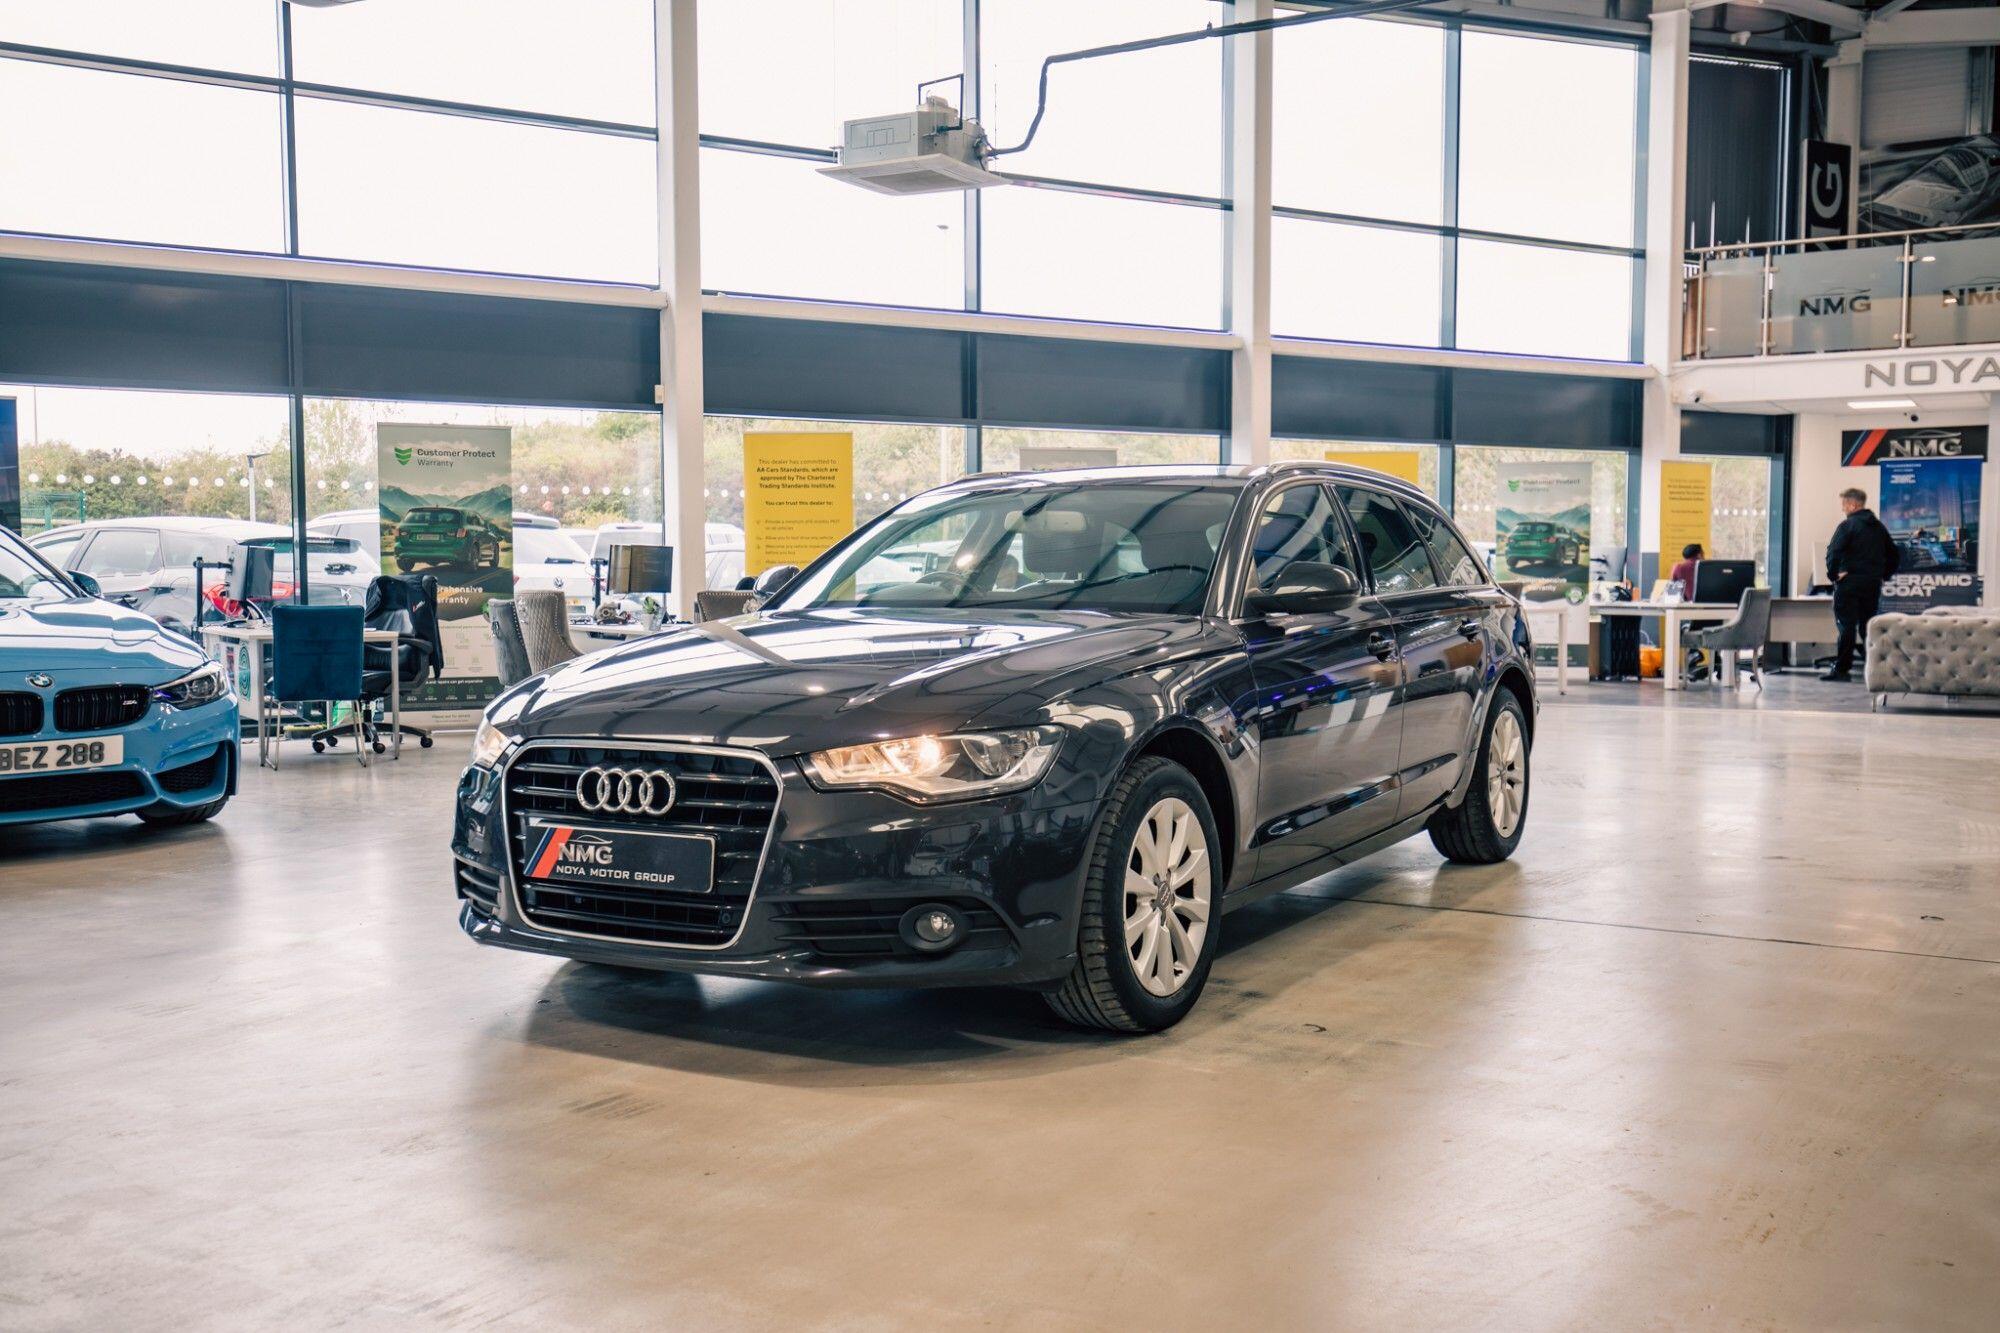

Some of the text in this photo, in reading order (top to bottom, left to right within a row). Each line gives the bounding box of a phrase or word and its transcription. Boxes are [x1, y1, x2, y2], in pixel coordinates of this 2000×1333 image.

[1800, 295, 1871, 316] NMG
[1942, 286, 2000, 307] NM
[1865, 356, 2000, 388] NOYA
[417, 448, 496, 458] Customer Protect
[1889, 438, 1962, 457] NMG
[417, 460, 454, 468] Warranty
[437, 596, 469, 605] arranty
[1881, 586, 1937, 597] COAT
[0, 742, 105, 771] BEZ 288
[558, 843, 613, 865] NMG
[556, 864, 675, 884] NOYA MOTOR GROUP
